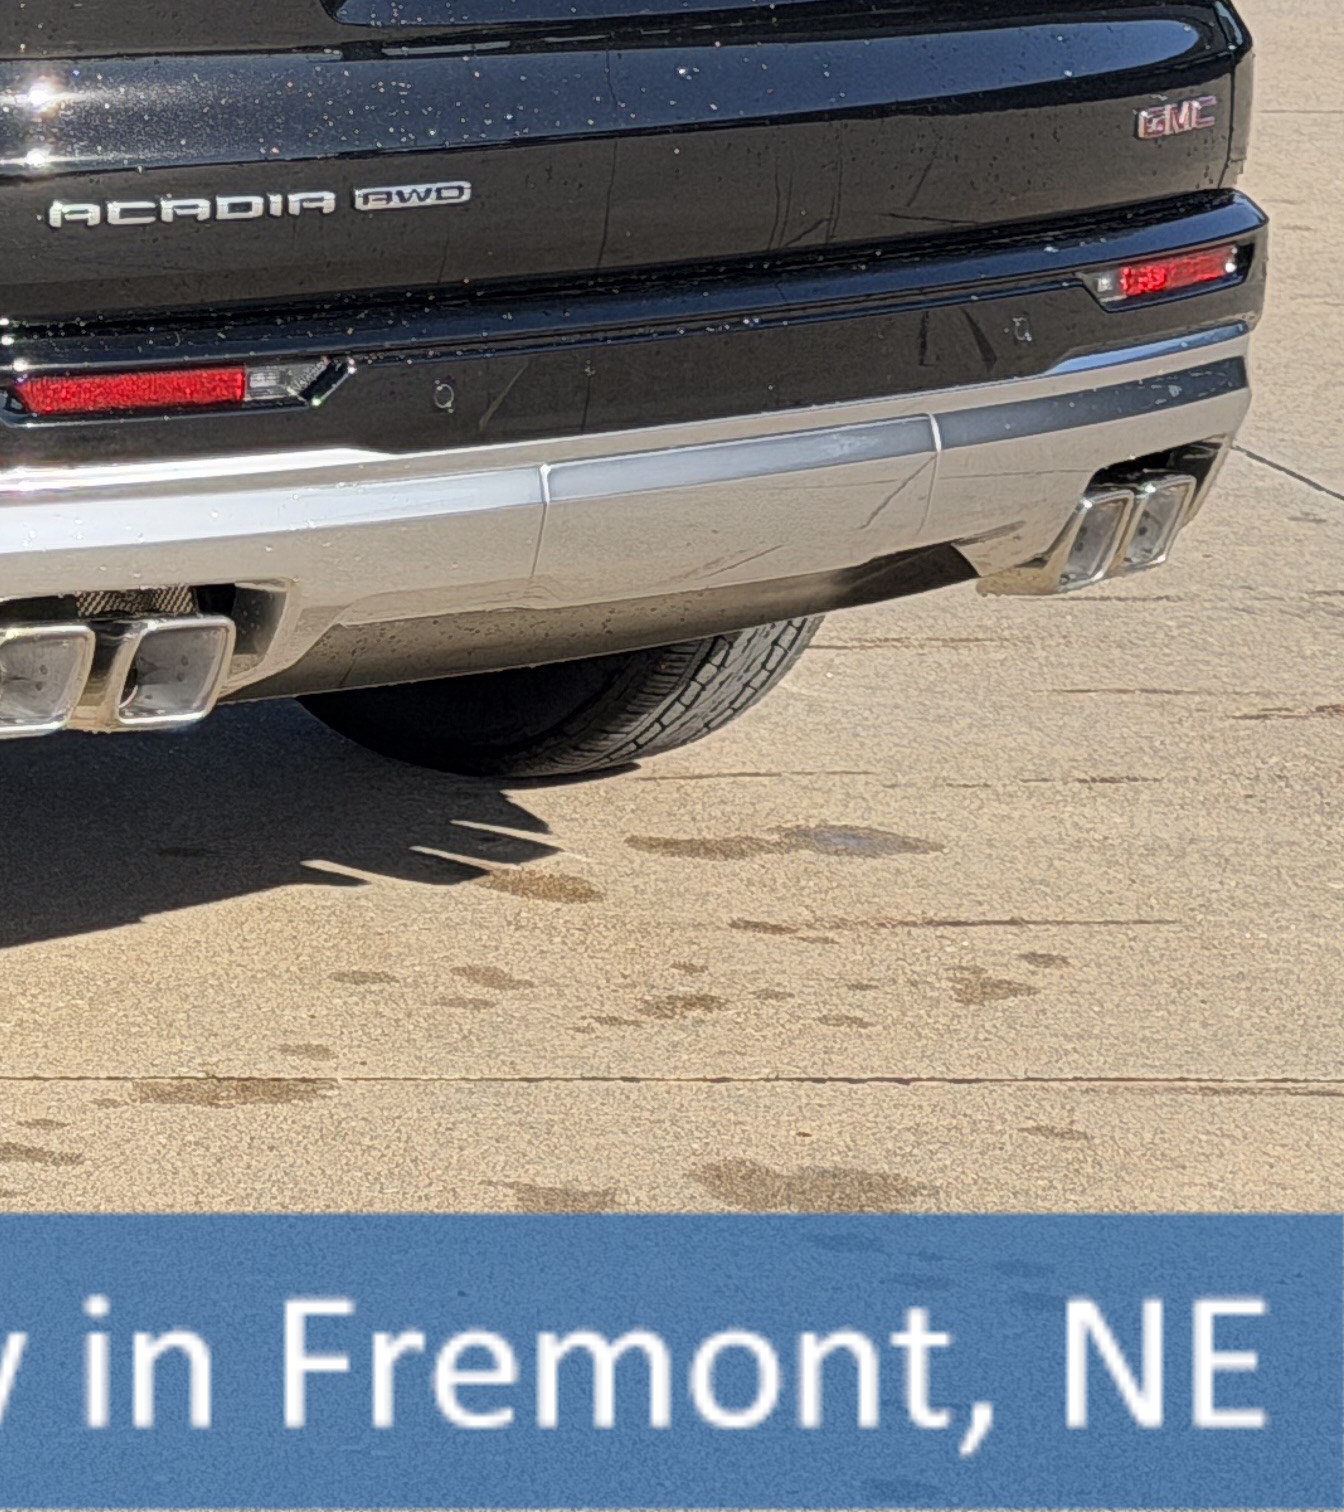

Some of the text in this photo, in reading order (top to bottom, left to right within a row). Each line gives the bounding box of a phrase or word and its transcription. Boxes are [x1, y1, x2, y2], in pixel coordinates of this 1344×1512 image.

[1137, 95, 1218, 139] GMC
[48, 182, 470, 228] ACADIA AWD
